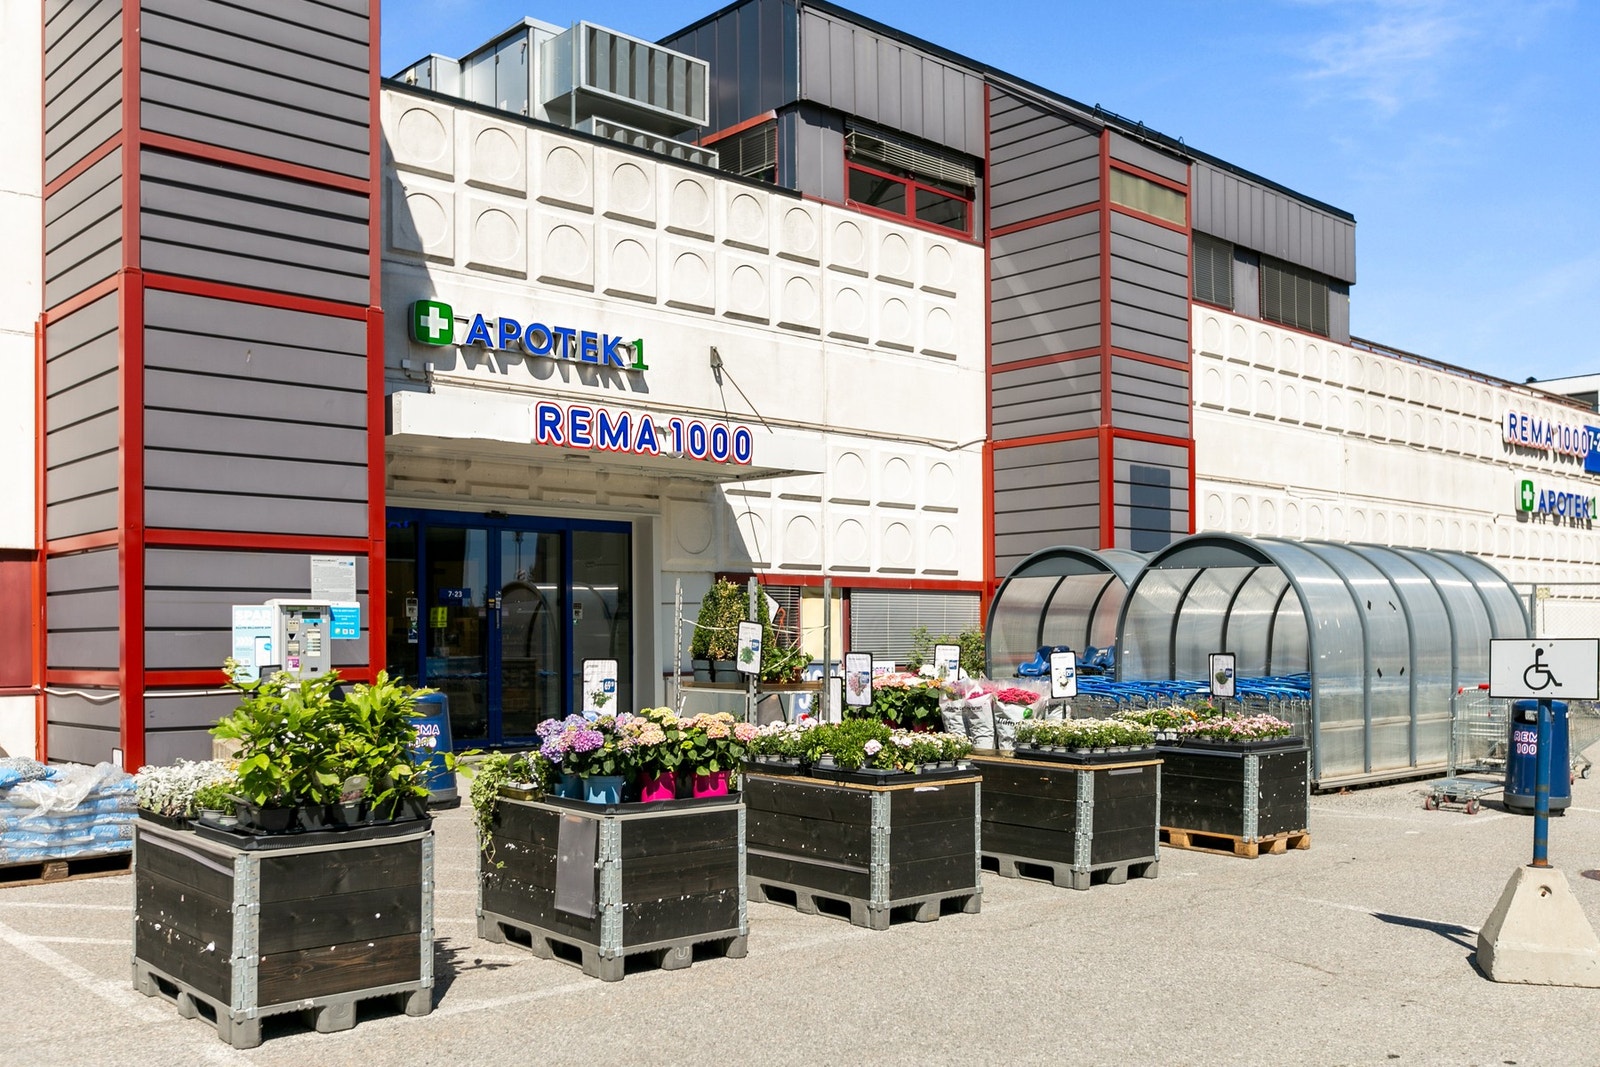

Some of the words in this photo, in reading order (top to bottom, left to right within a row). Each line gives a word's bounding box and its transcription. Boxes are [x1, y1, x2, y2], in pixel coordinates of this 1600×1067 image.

[465, 312, 626, 367] APOTEK
[631, 338, 649, 371] 1
[535, 400, 661, 457] REMA
[669, 416, 754, 466] 1000
[1507, 409, 1553, 450] REMA
[1555, 423, 1589, 458] 1000
[1538, 488, 1590, 519] APOTEK
[1591, 496, 1598, 520] 1
[447, 589, 463, 599] 7-23
[1513, 730, 1538, 743] REM
[1516, 743, 1537, 755] 100
